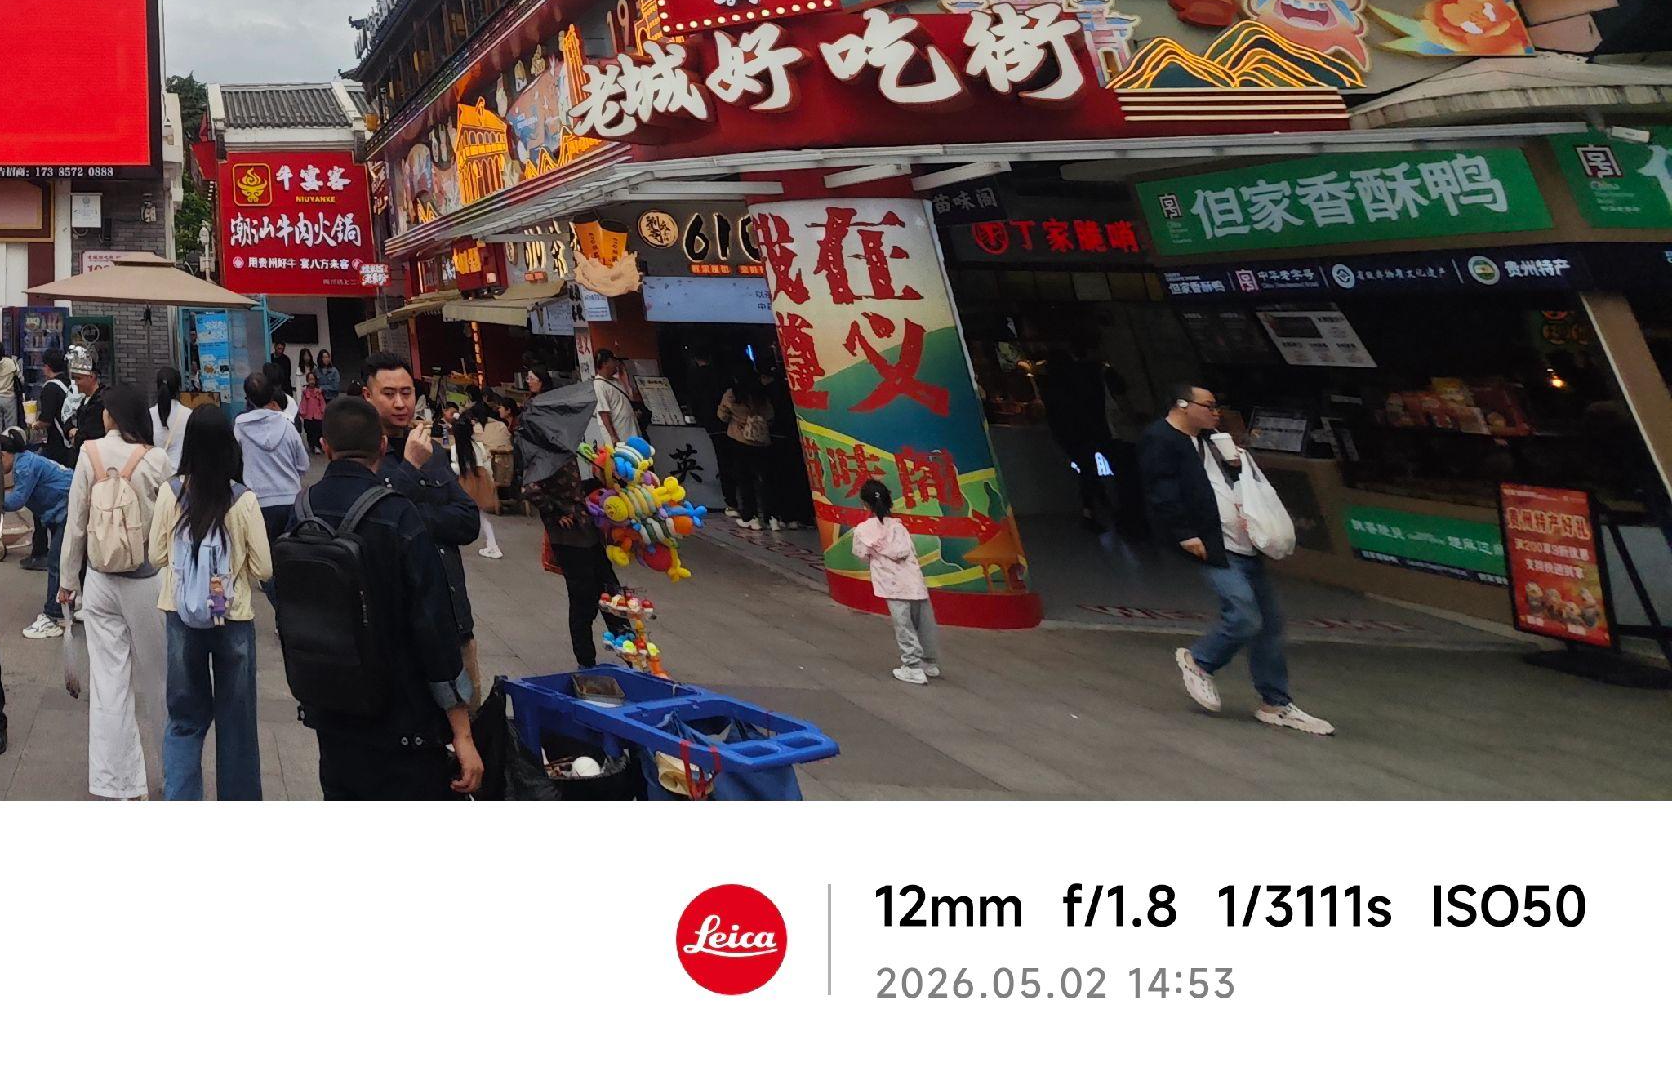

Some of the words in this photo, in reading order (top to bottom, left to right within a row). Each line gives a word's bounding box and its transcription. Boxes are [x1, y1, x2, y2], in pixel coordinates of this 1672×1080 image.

[568, 3, 1090, 138] 老城好吃街
[35, 167, 53, 177] 173
[58, 167, 83, 177] 8572
[932, 187, 998, 215] 苗味阁
[1190, 152, 1509, 240] 但家香酥鸭
[230, 211, 362, 248] 潮汕牛肉火锅
[300, 258, 350, 270] 宴八方来客
[1257, 268, 1315, 280] 中华老字号
[1504, 258, 1571, 278] 贵州特产
